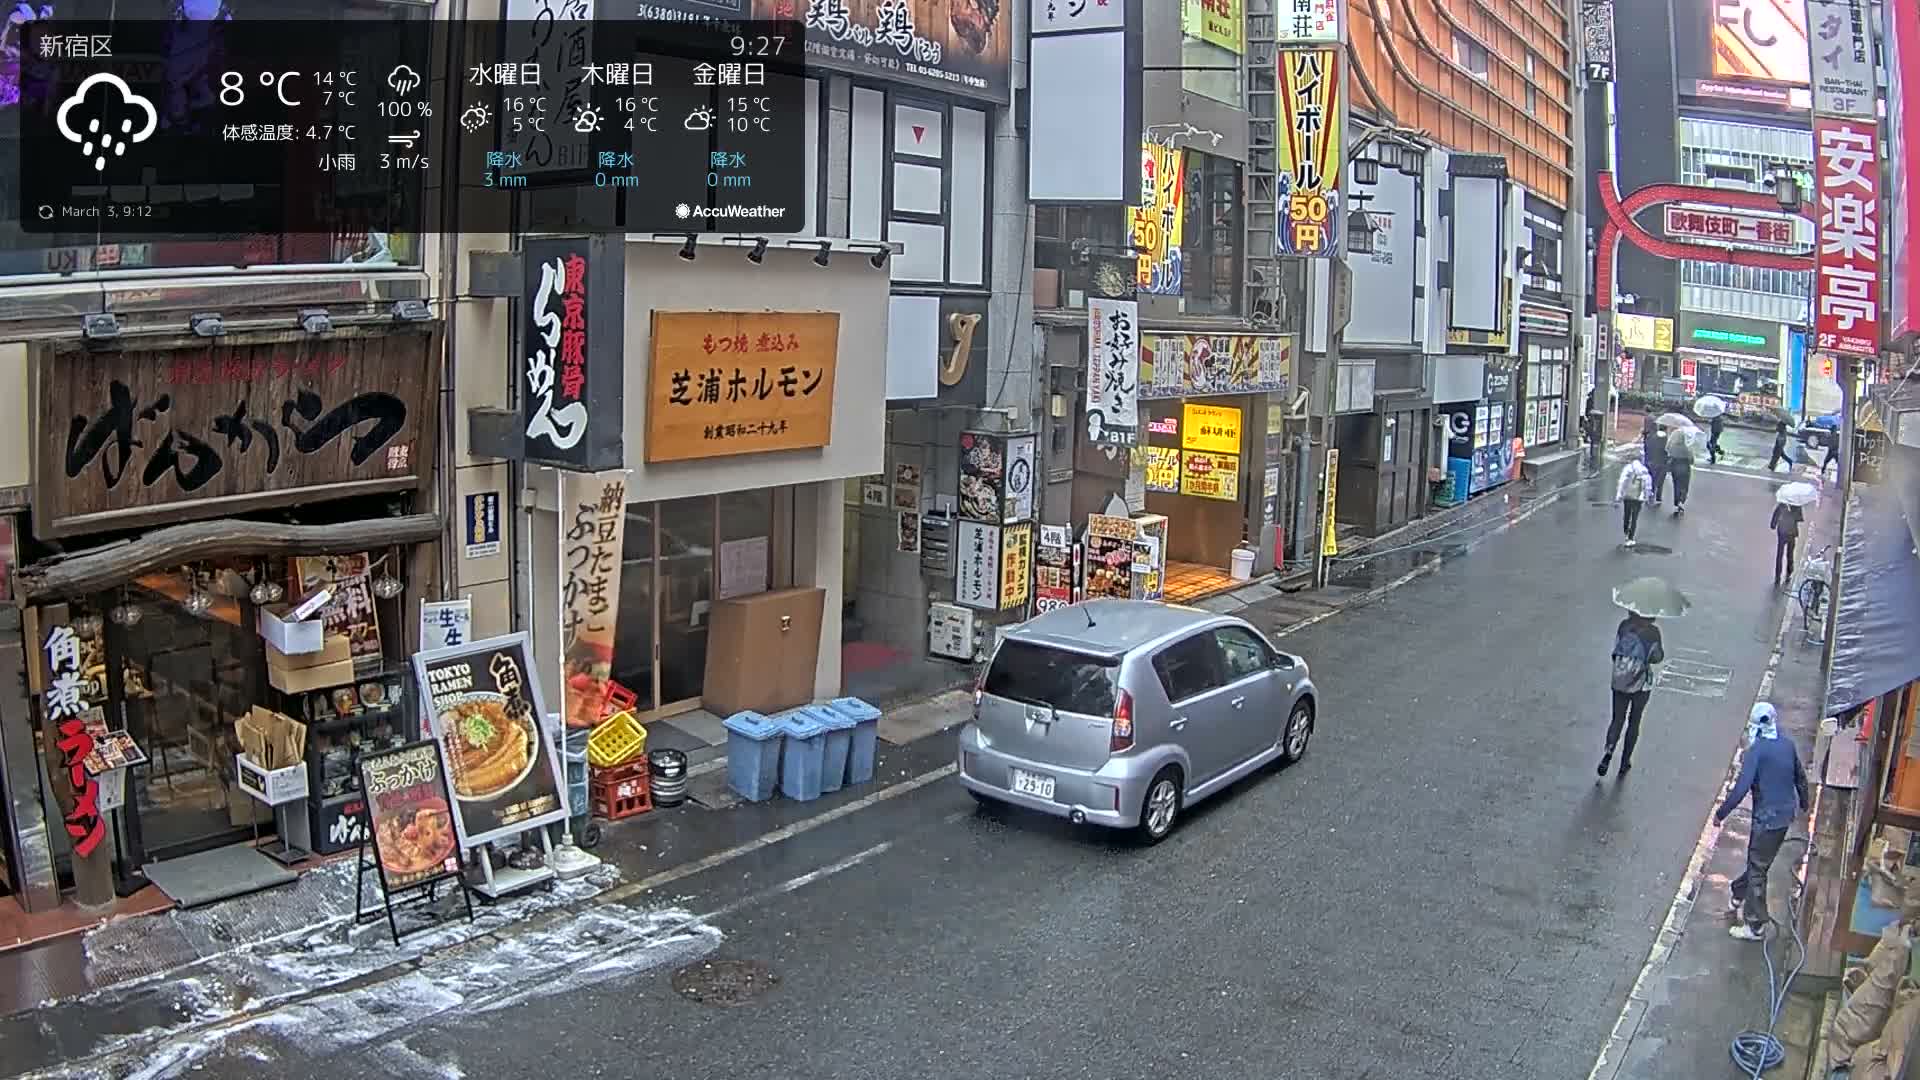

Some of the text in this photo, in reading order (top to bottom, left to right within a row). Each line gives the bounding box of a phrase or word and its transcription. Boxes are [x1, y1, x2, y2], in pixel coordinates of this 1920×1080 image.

[1817, 14, 1844, 71] タイ
[1589, 63, 1610, 80] 7F
[1293, 52, 1324, 191] ハイボール
[1832, 97, 1857, 112] 3F
[1289, 194, 1328, 222] 50
[1669, 210, 1794, 239] 歌舞伎町一番街
[1819, 126, 1877, 331] 安楽亭
[561, 252, 586, 400] 東京豚骨
[702, 331, 801, 355] もつ焼 煮込み
[1818, 333, 1837, 348] 2F
[1104, 309, 1136, 414] お好み焼き
[668, 365, 824, 407] 芝浦ホルモン
[65, 379, 408, 493] ばんから
[702, 419, 789, 441] 創業昭和二十九年
[1109, 431, 1136, 444] B1F
[588, 481, 625, 633] 納豆たまご
[972, 526, 984, 600] 芝浦ホルモン
[44, 624, 92, 721] 角煮
[428, 663, 472, 684] TOKYO
[431, 676, 474, 696] RAMEN
[433, 691, 465, 709] SHOP
[56, 718, 107, 859] ラーメン
